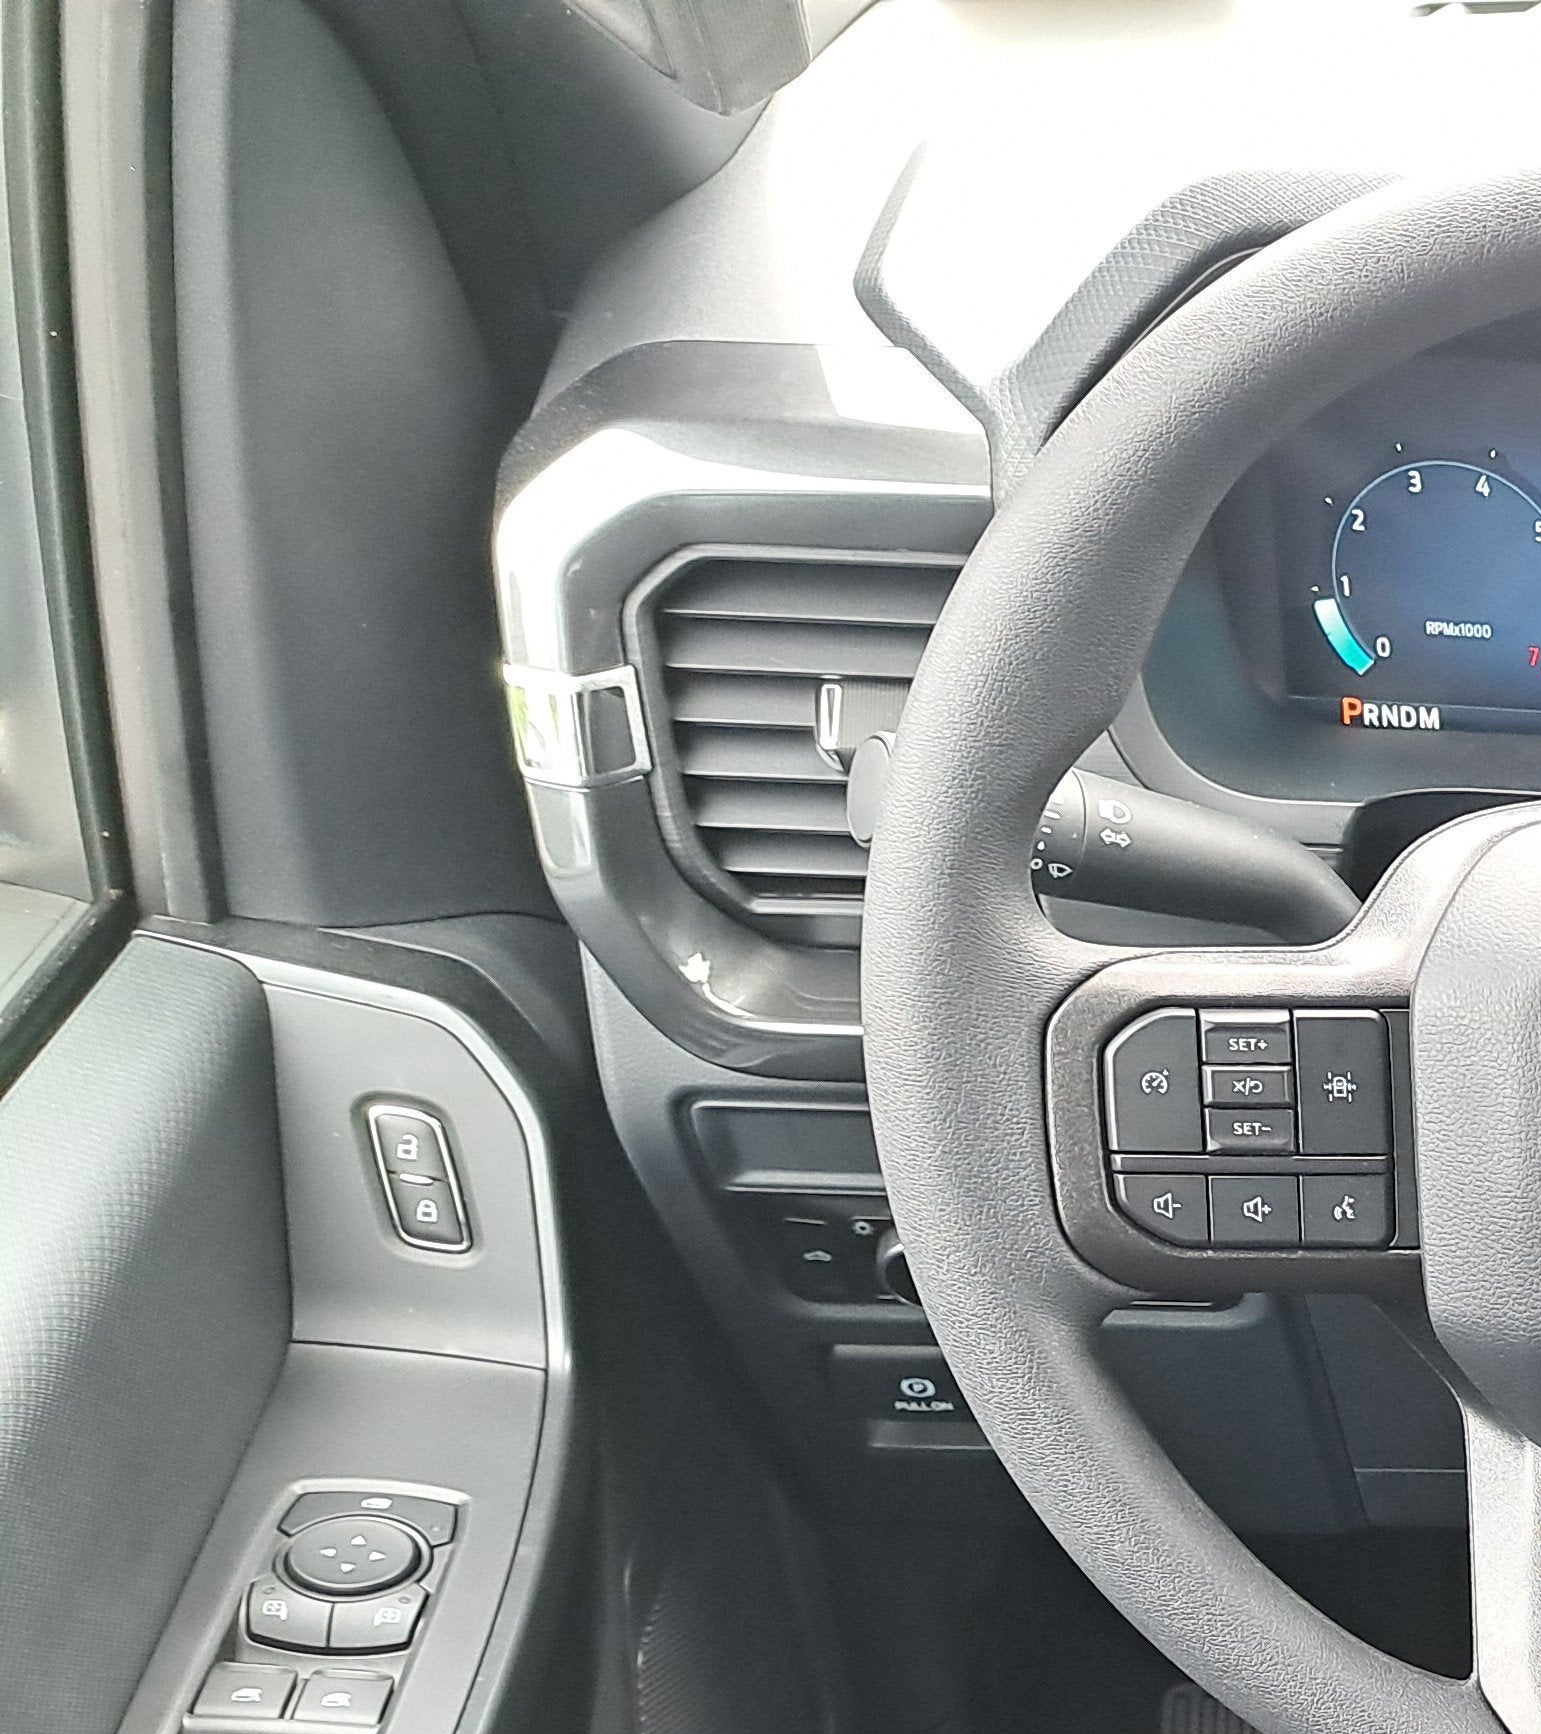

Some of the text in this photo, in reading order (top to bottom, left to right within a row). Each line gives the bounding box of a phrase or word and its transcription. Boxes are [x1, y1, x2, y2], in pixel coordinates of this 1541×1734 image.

[1408, 471, 1422, 493] 3
[1475, 475, 1490, 497] 4
[1351, 509, 1366, 531] 2
[1340, 575, 1352, 597] 1
[1426, 621, 1492, 640] RPMx1000
[1376, 637, 1391, 658] 0
[1528, 646, 1541, 667] 7
[1228, 1037, 1269, 1051] SET+
[1233, 1122, 1272, 1136] SET-
